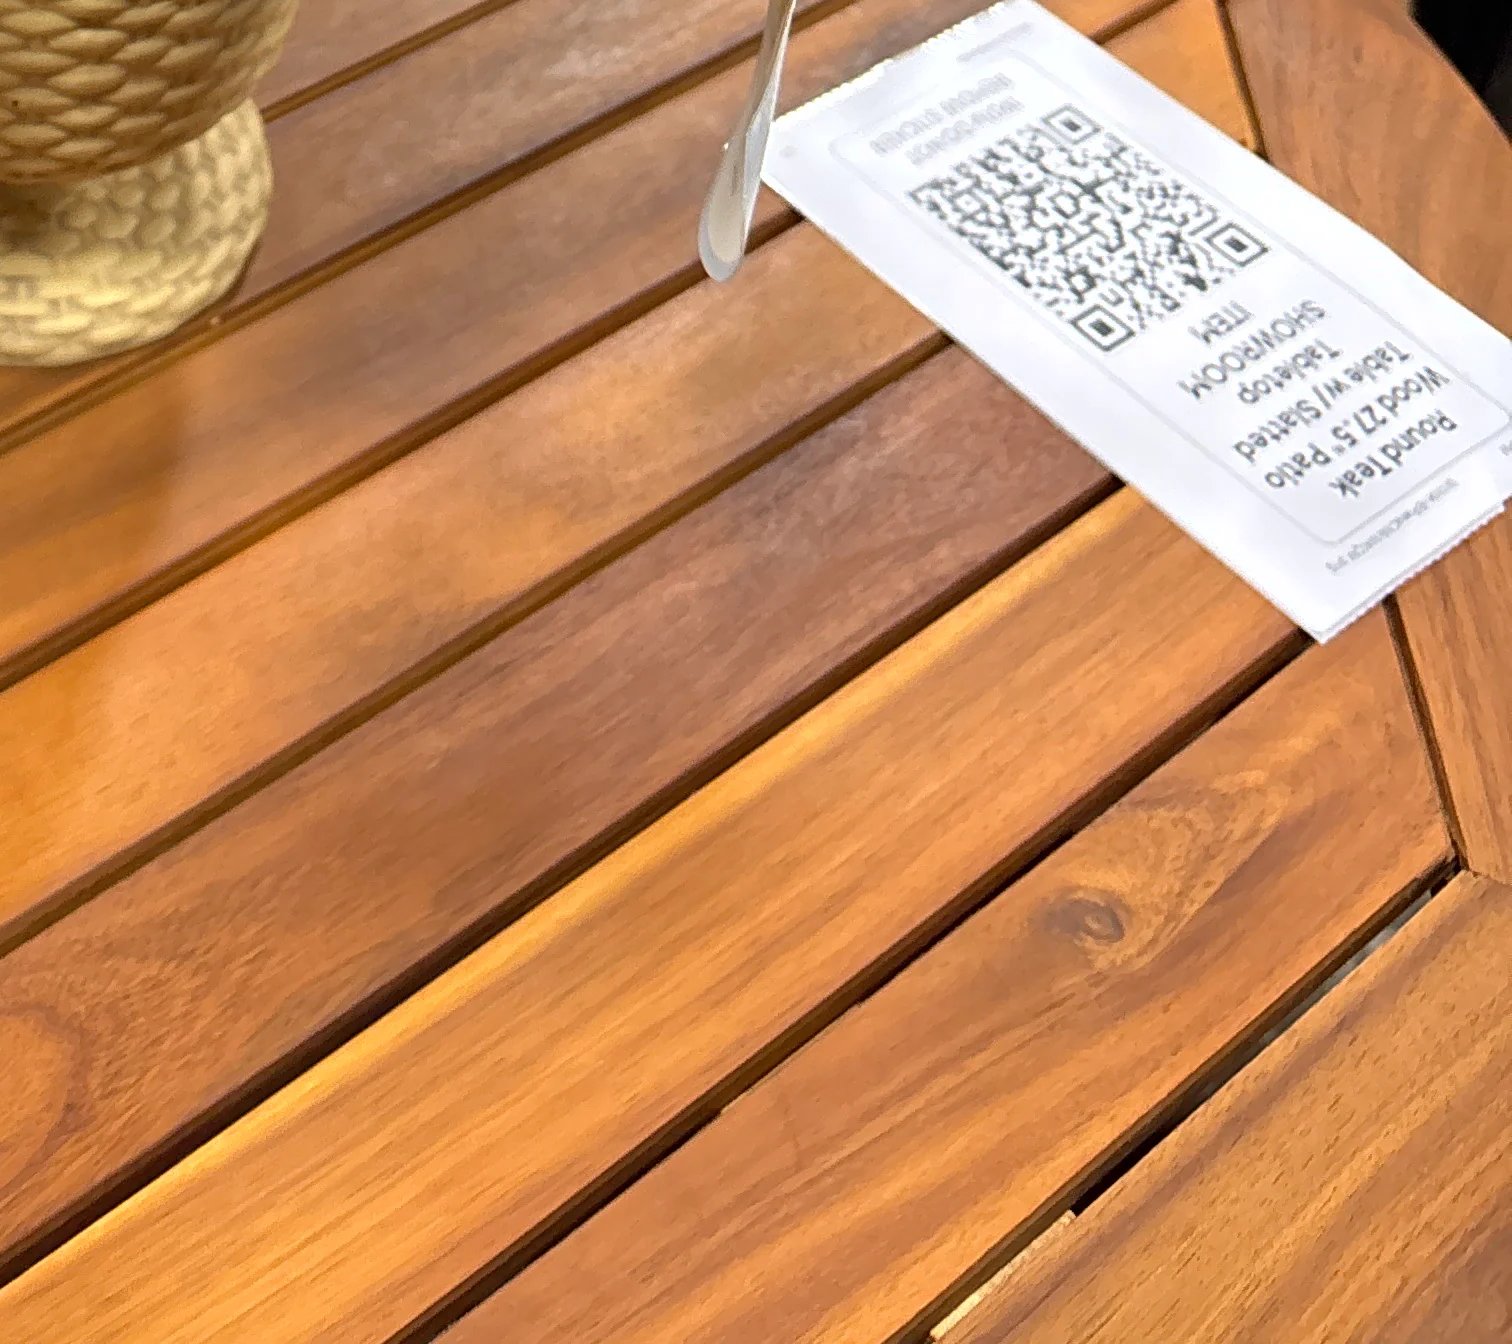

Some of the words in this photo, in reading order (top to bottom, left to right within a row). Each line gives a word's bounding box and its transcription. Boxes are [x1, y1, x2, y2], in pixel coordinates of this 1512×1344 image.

[1189, 301, 1252, 345] ITEM
[1177, 299, 1326, 400] SHOWROOM
[1236, 339, 1341, 405] Tabletop
[1342, 340, 1411, 383] Table
[1310, 377, 1352, 410] w/
[1374, 365, 1450, 418] Wood
[1231, 398, 1323, 465] Slatted
[1377, 408, 1458, 468] Round
[1263, 441, 1333, 489] Patio
[1327, 454, 1394, 499] Teak
